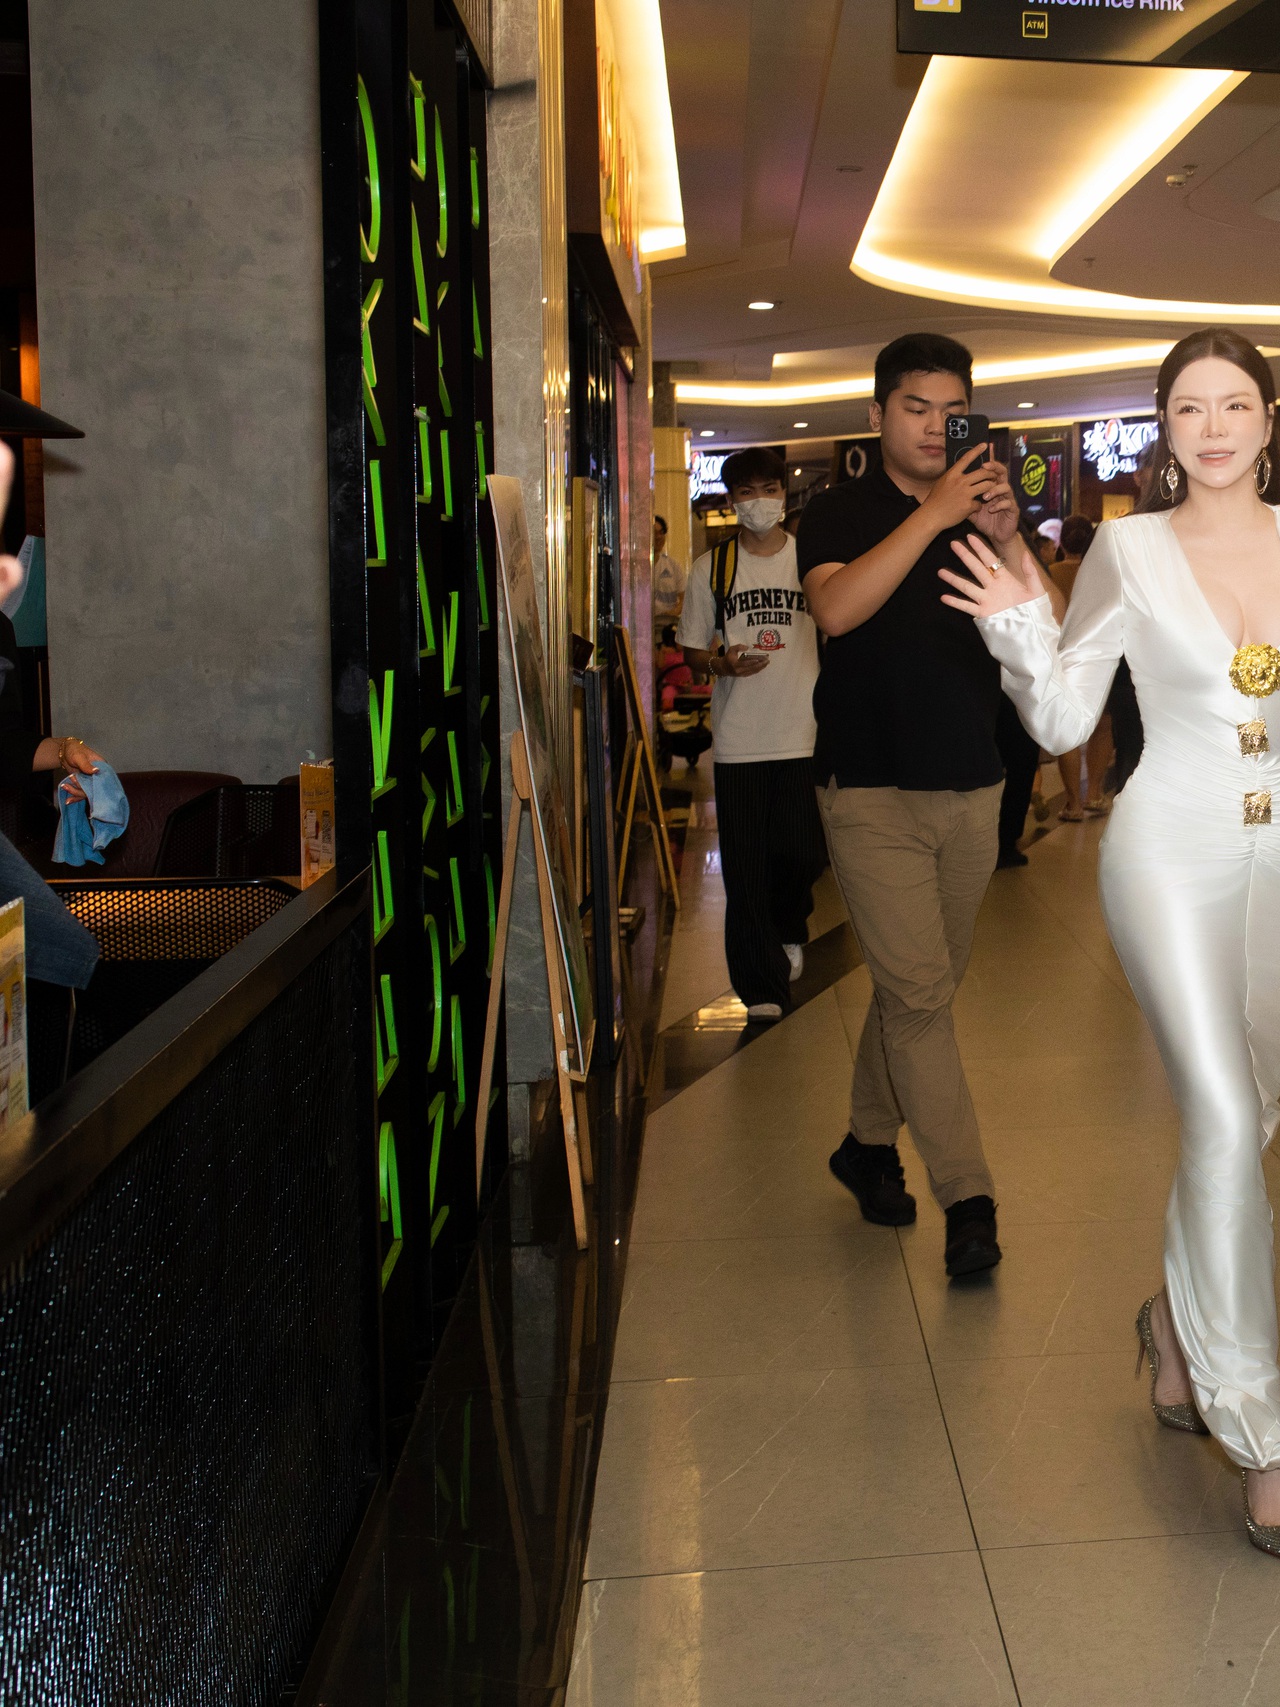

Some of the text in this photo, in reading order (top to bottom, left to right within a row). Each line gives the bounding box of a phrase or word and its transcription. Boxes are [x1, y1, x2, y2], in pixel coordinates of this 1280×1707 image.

[1026, 20, 1045, 30] ATM
[724, 588, 811, 620] WHENEVE
[747, 612, 792, 626] ATELIER
